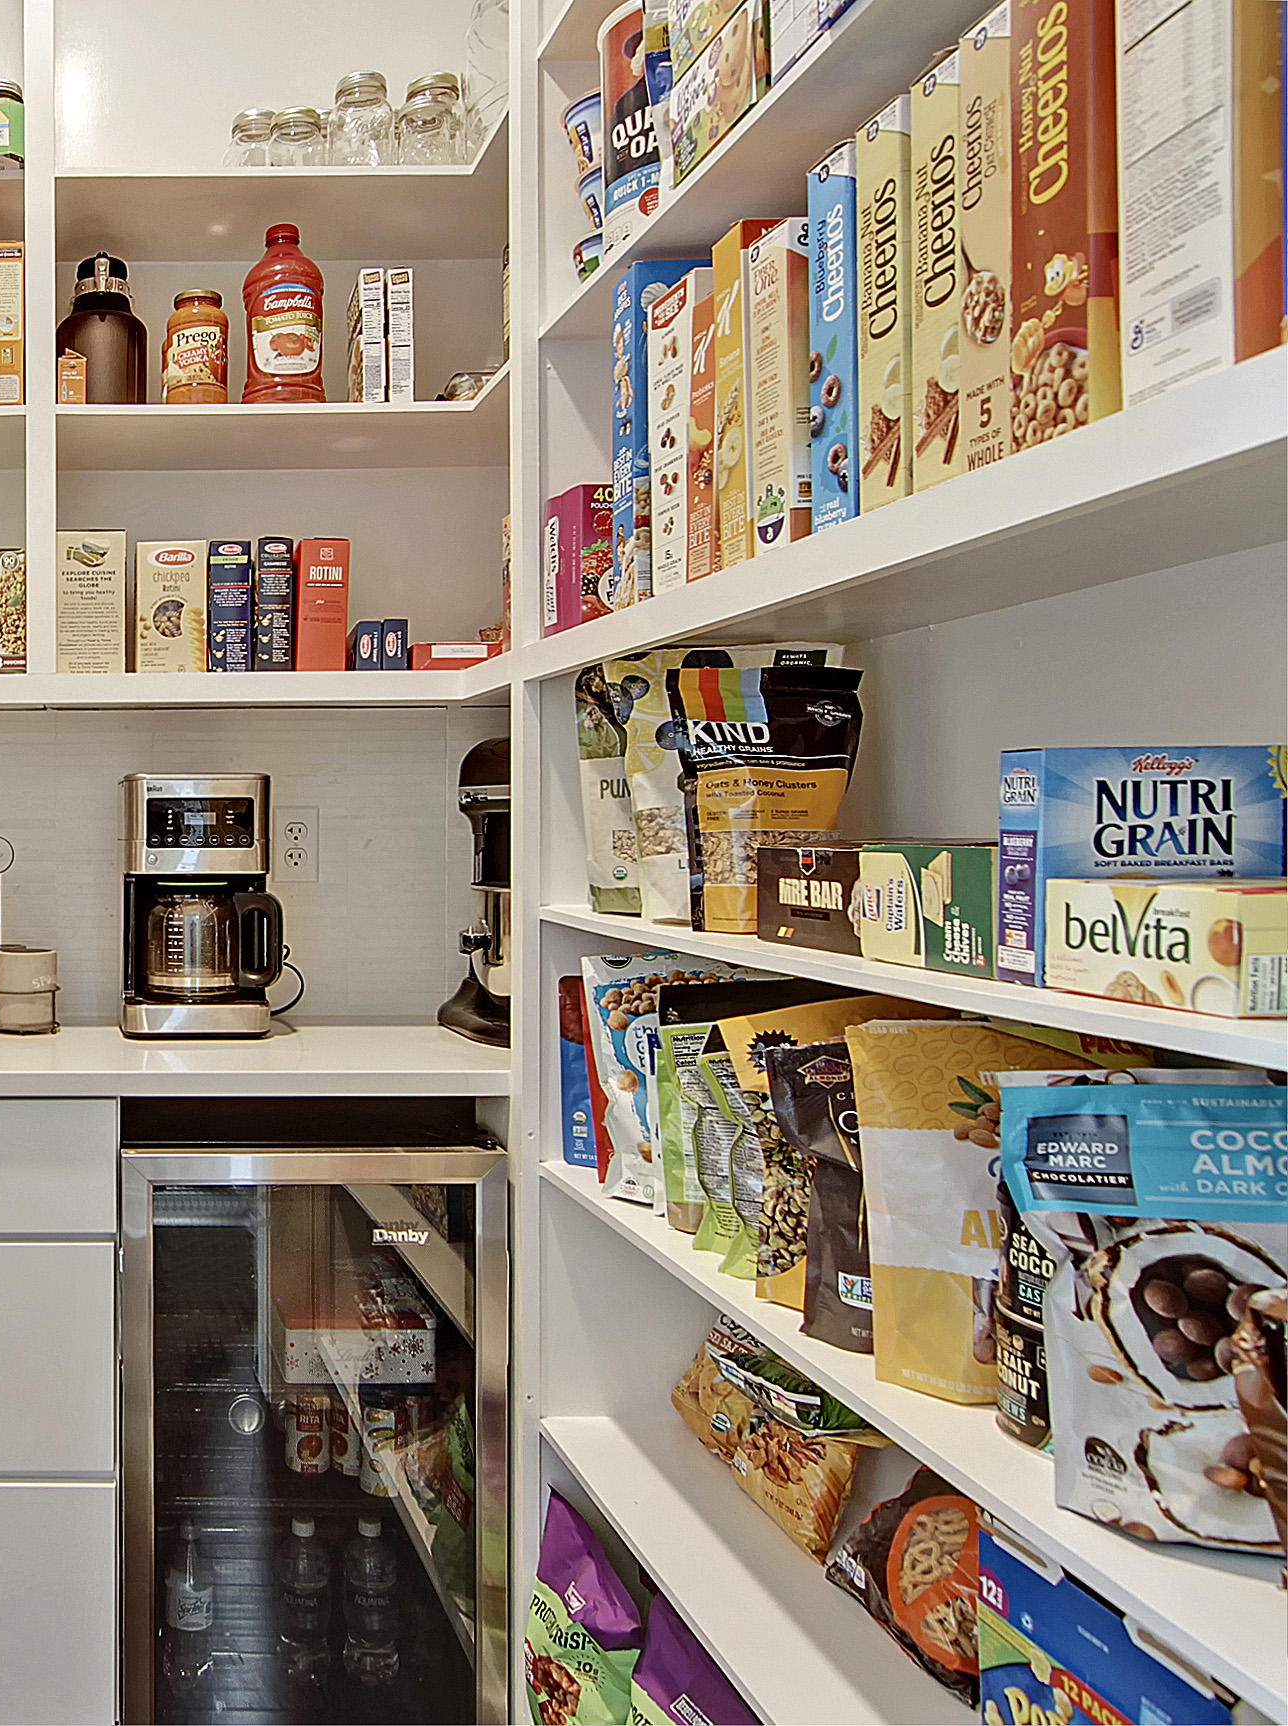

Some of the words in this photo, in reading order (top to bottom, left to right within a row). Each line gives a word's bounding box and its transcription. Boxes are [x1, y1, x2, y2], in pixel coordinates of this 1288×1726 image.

[1019, 40, 1033, 84] Nut
[1029, 2, 1068, 205] Cheerios
[1019, 87, 1036, 153] Honey
[962, 96, 982, 210] Cheerios
[916, 164, 928, 201] Nut
[861, 203, 872, 239] Nut
[924, 134, 955, 308] Cheerios
[815, 219, 826, 294] Blueberry
[916, 205, 928, 278] Banana
[823, 203, 844, 322] Cheerios
[869, 178, 898, 340] Cheerios
[861, 242, 872, 311] Banana
[264, 294, 314, 311] Campbell's
[177, 331, 216, 347] Prego
[979, 396, 991, 428] 5
[967, 441, 1004, 472] WHOLE
[4, 557, 15, 565] 90
[159, 552, 192, 563] Barilla
[309, 566, 342, 580] ROTINI
[153, 571, 190, 583] chickpea
[688, 720, 771, 745] KIND
[694, 744, 737, 760] HEALTHY
[738, 745, 773, 753] GRAINS
[1132, 754, 1194, 775] Kellogg's
[705, 780, 730, 789] Oats
[732, 779, 739, 787] &
[743, 779, 773, 790] Honey
[775, 780, 817, 789] Clusters
[724, 790, 755, 798] Toasted
[757, 789, 785, 798] Coconut
[1003, 789, 1037, 803] GRAIN
[1004, 776, 1036, 790] NUTRI
[1096, 778, 1232, 826] NUTRI
[1093, 813, 1236, 859] GRAIN
[1094, 860, 1118, 868] SOFT
[1154, 859, 1208, 867] BREAKFAST
[778, 877, 809, 907] MRE
[810, 881, 843, 911] BAR
[886, 878, 894, 932] Captain's
[894, 879, 904, 931] Wafers
[943, 921, 953, 962] Cream
[952, 918, 961, 963] Cheese
[960, 922, 970, 965] Chives
[1065, 892, 1191, 964] belVita
[1036, 1141, 1119, 1156] EDWARD
[1049, 1154, 1107, 1169] MARC
[1032, 1171, 1125, 1185] CHOCOLATIER
[1196, 1178, 1266, 1195] DARK
[373, 1228, 430, 1245] Danby
[1012, 1232, 1039, 1256] SEA
[299, 1414, 321, 1425] RITA
[1061, 1675, 1079, 1700] 12
